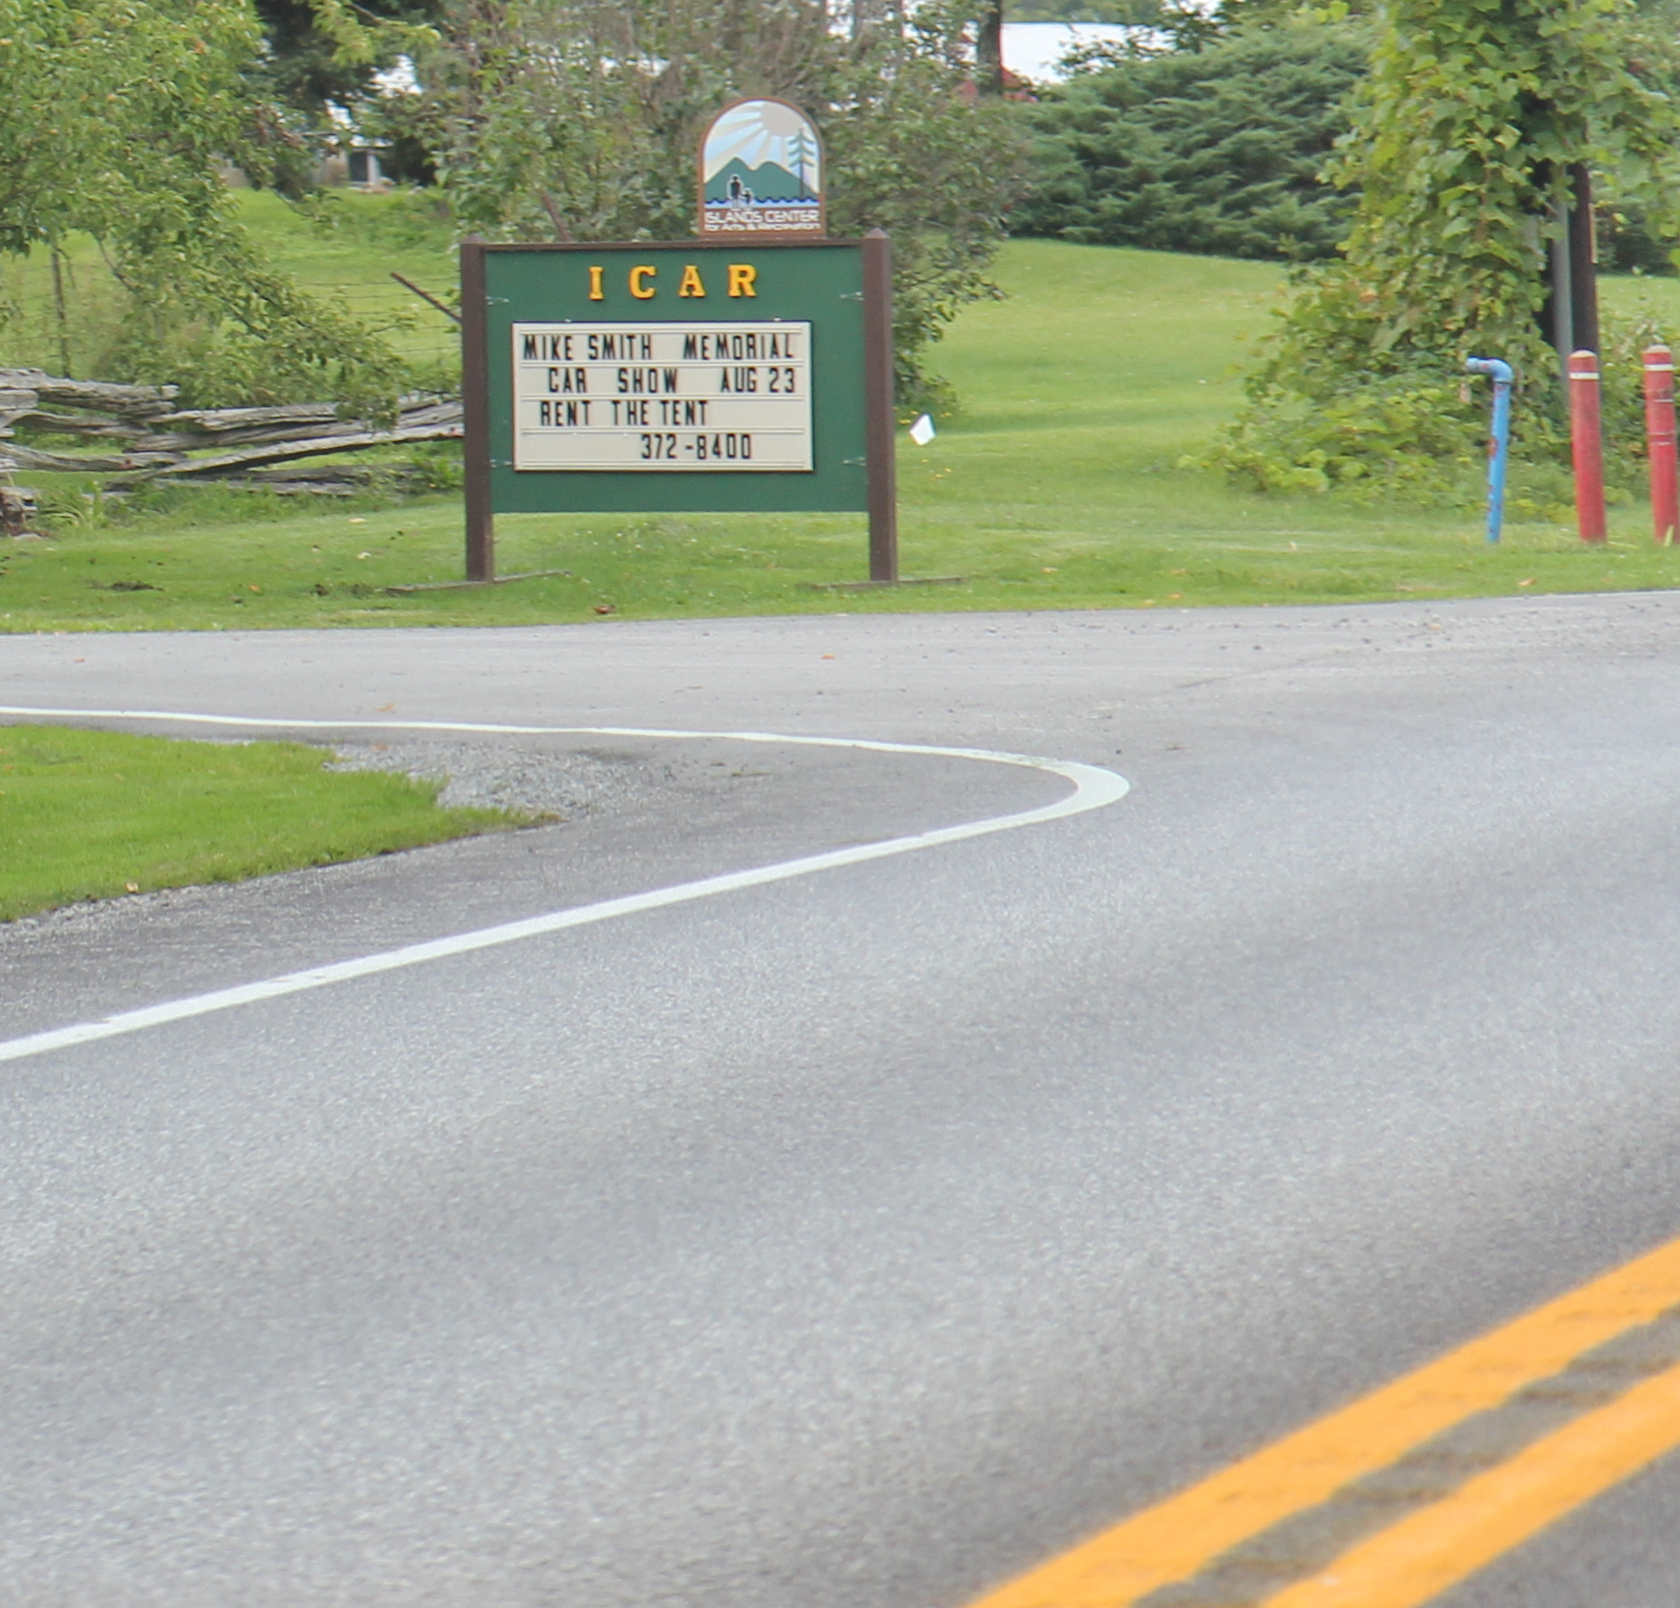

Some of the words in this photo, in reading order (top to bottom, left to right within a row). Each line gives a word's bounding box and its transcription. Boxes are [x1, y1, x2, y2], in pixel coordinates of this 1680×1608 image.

[705, 211, 762, 223] ISLANDS
[764, 210, 819, 222] CENTER
[523, 334, 573, 361] MIKE
[588, 334, 652, 361] SMITH
[683, 333, 794, 361] MEMORIAL
[548, 367, 587, 393] CAR
[618, 367, 678, 393] SHOW
[721, 367, 757, 393] AUG
[768, 367, 795, 393] 23
[540, 400, 591, 427] RENT
[612, 400, 648, 426] THE
[659, 400, 708, 426] TENT
[641, 434, 752, 460] 372-8400
